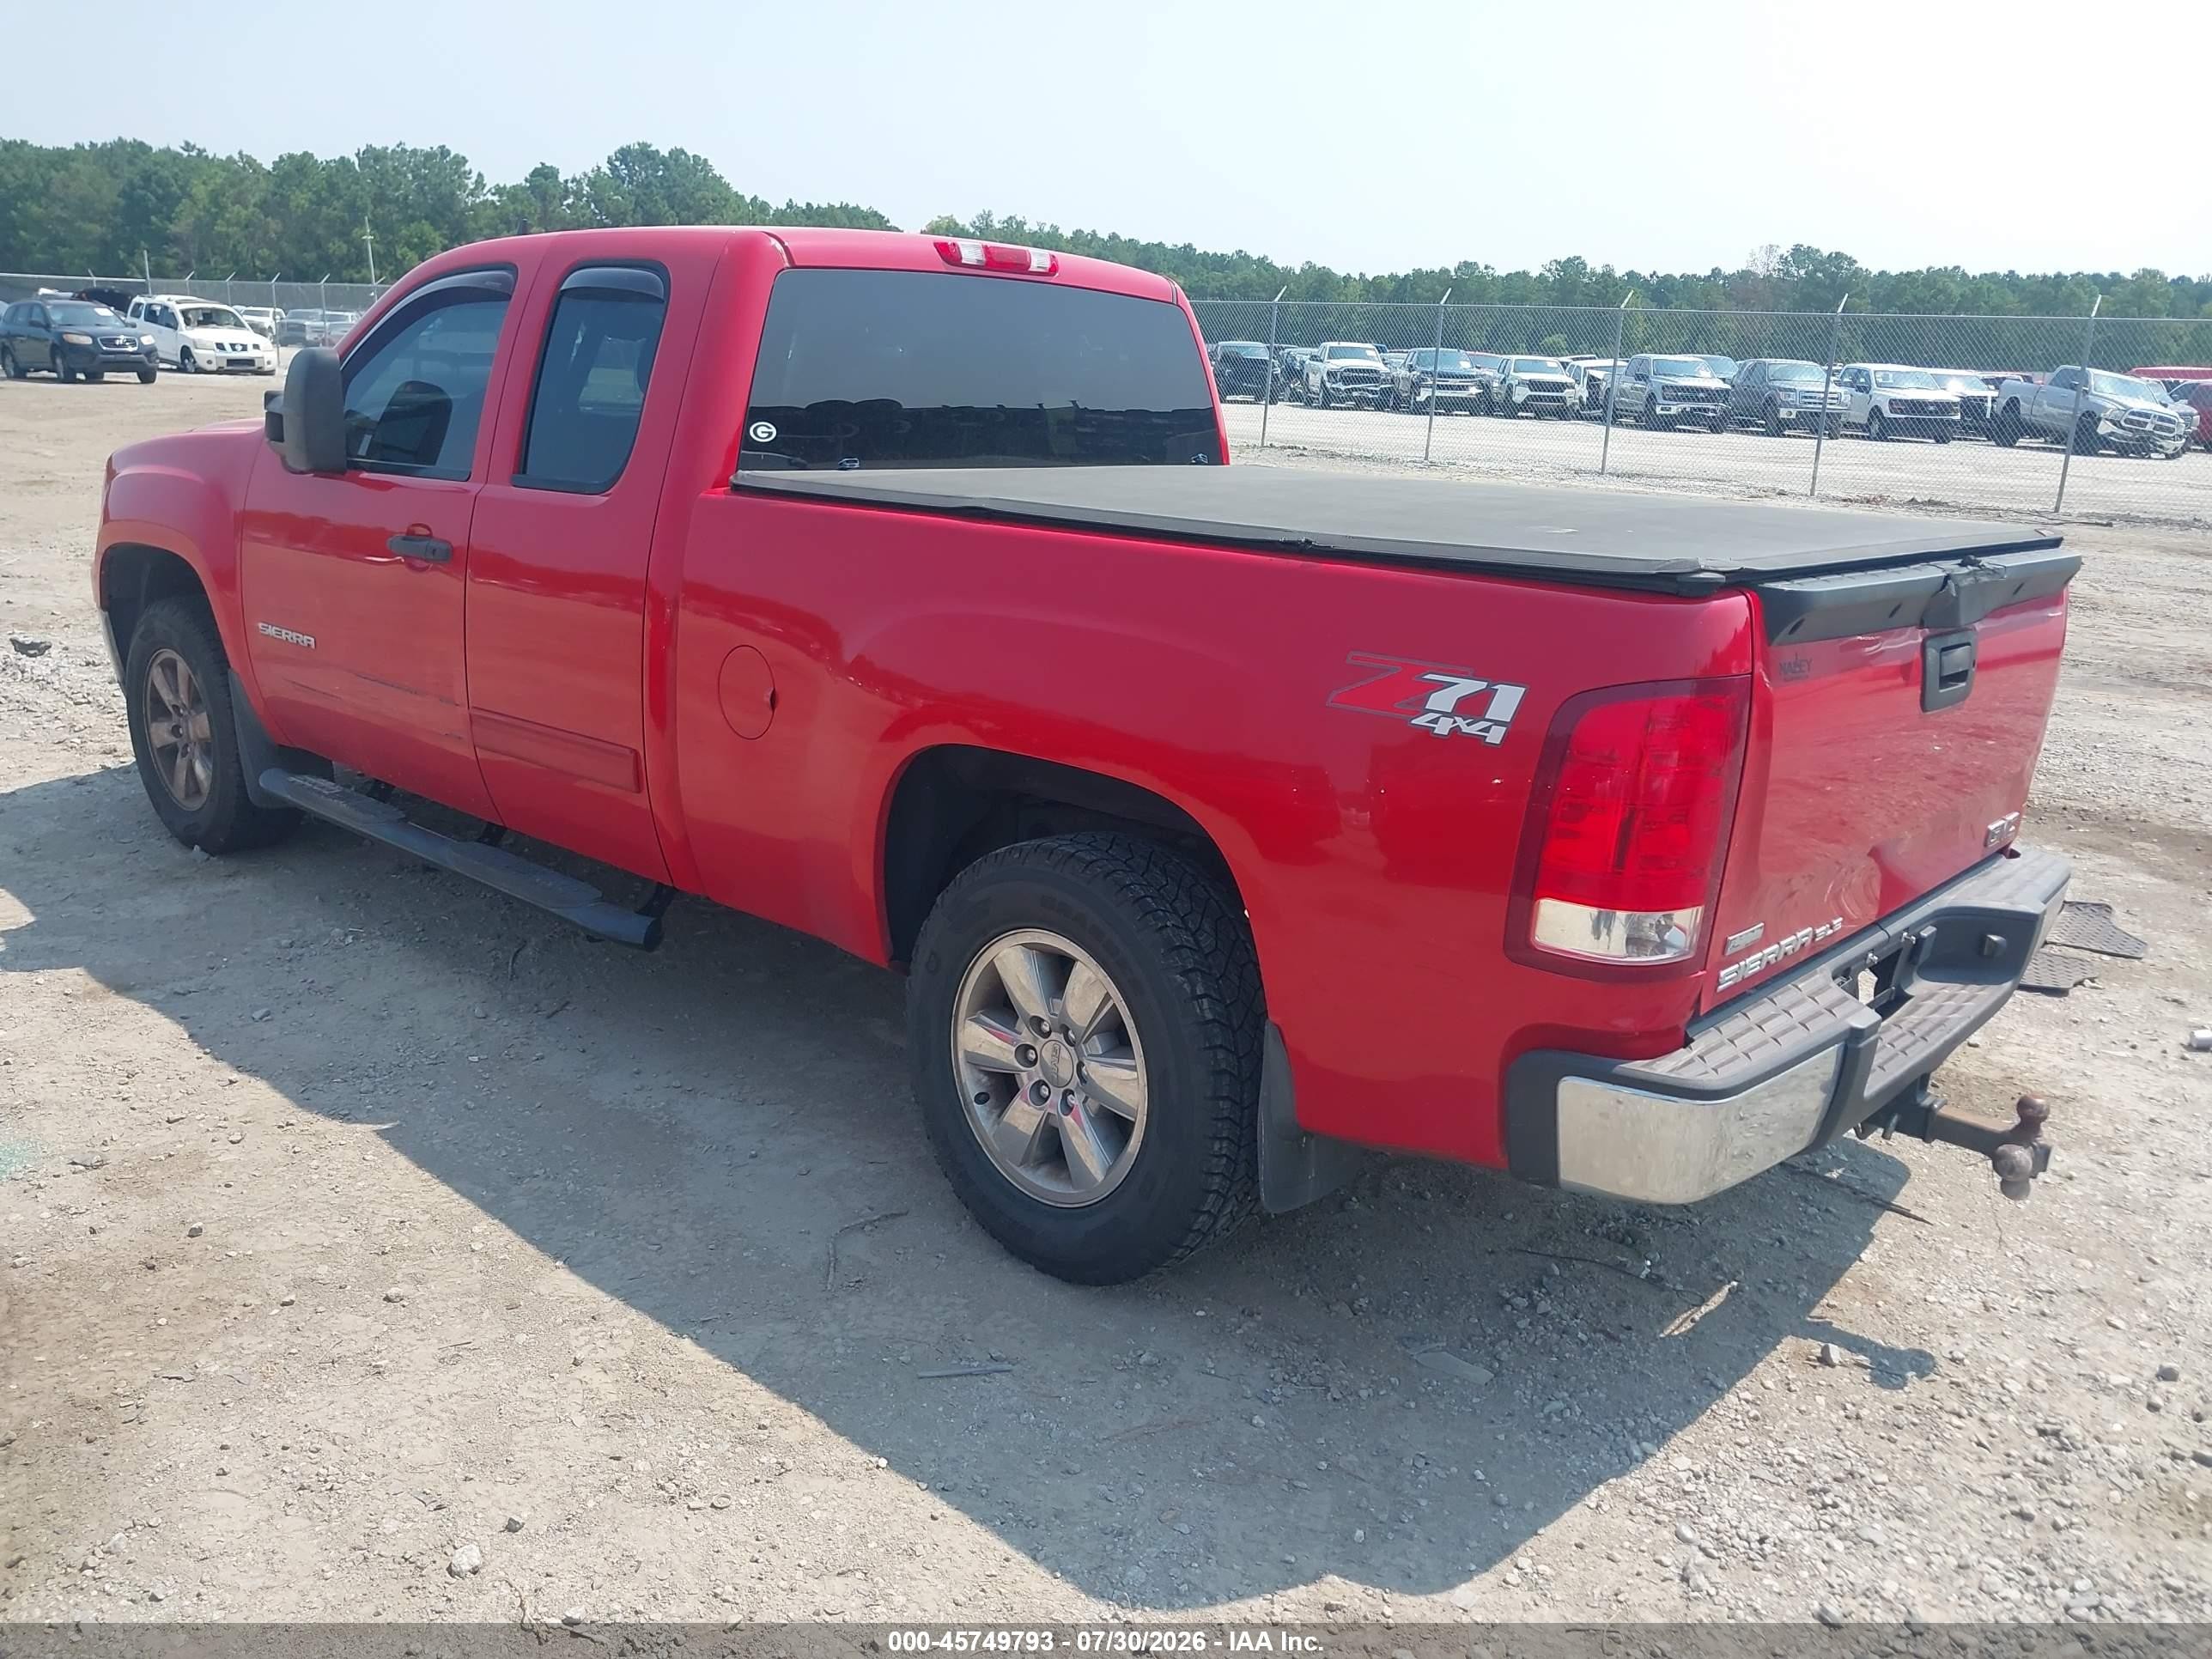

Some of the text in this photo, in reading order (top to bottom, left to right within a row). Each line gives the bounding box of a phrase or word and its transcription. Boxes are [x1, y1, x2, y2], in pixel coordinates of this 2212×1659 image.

[258, 622, 315, 649] SIERRA
[1327, 651, 1529, 723] Z71
[1717, 927, 1813, 993] SIERRA
